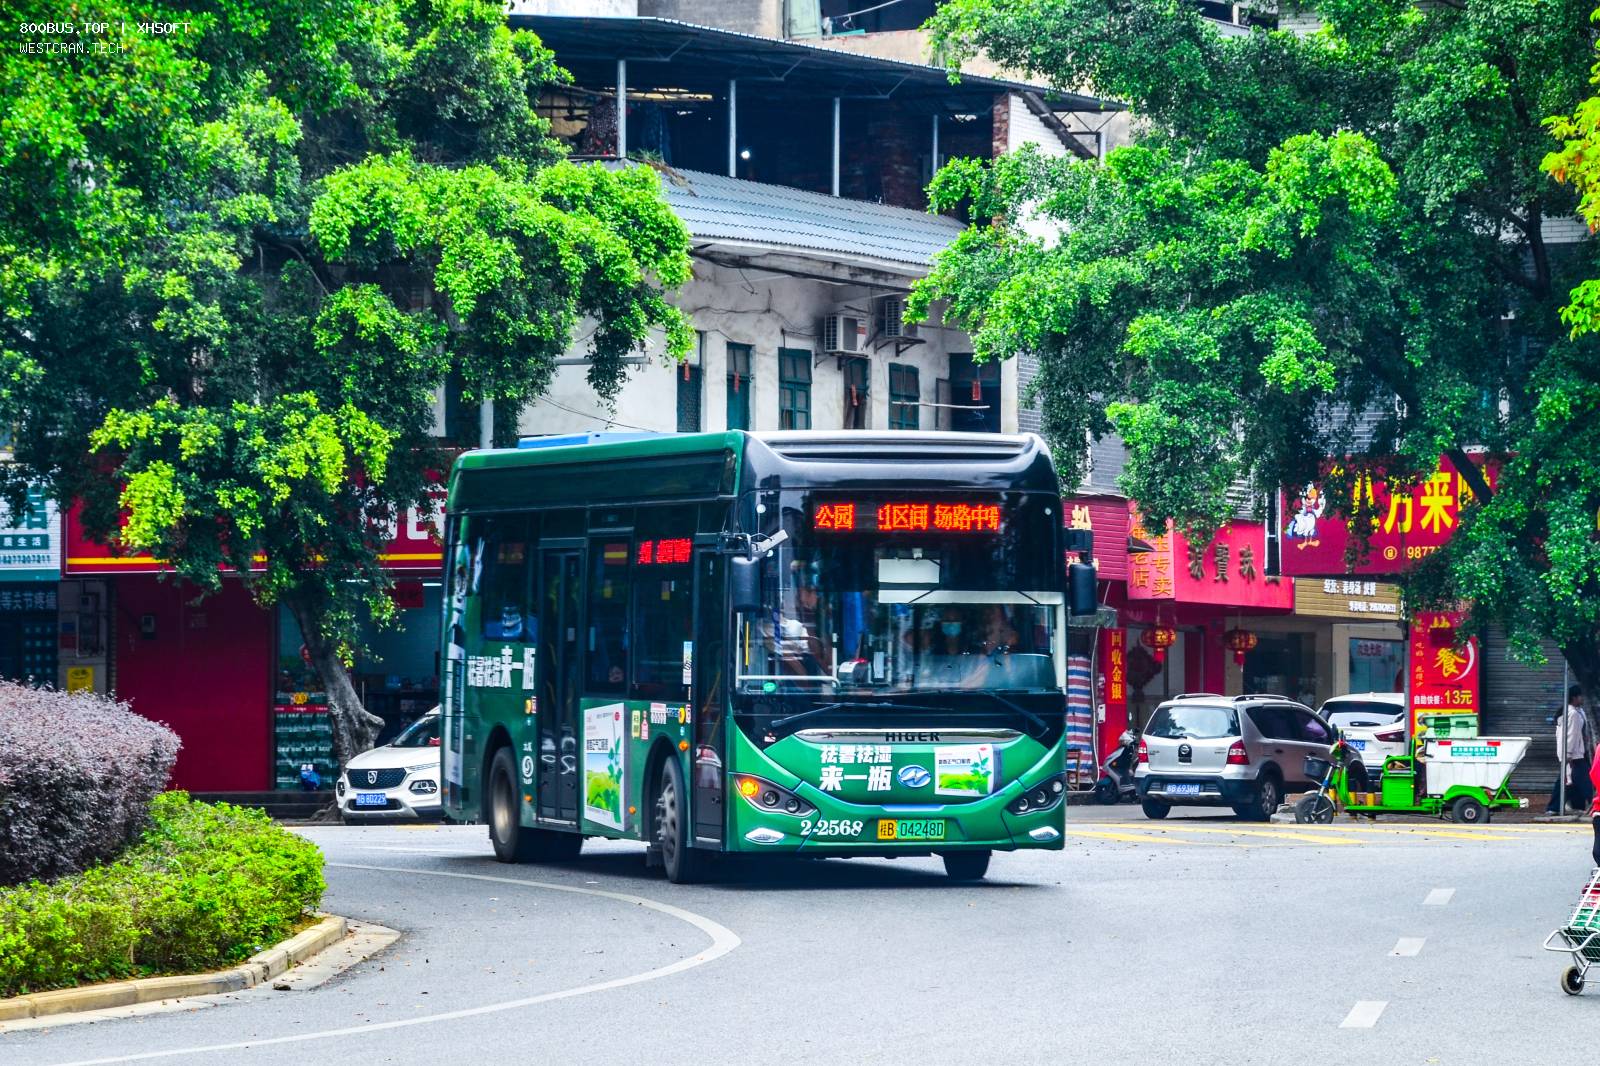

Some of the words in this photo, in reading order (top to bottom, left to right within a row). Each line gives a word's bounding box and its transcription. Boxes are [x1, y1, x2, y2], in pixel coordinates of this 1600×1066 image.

[815, 503, 854, 530] 公园
[878, 504, 929, 530] 1区间
[1407, 546, 1441, 559] 9877
[885, 731, 940, 742] HIGER
[820, 744, 892, 764] 祛暑祛湿
[819, 765, 893, 792] 来一瓶
[800, 819, 864, 836] 2-2568
[899, 821, 944, 837] 04248D
